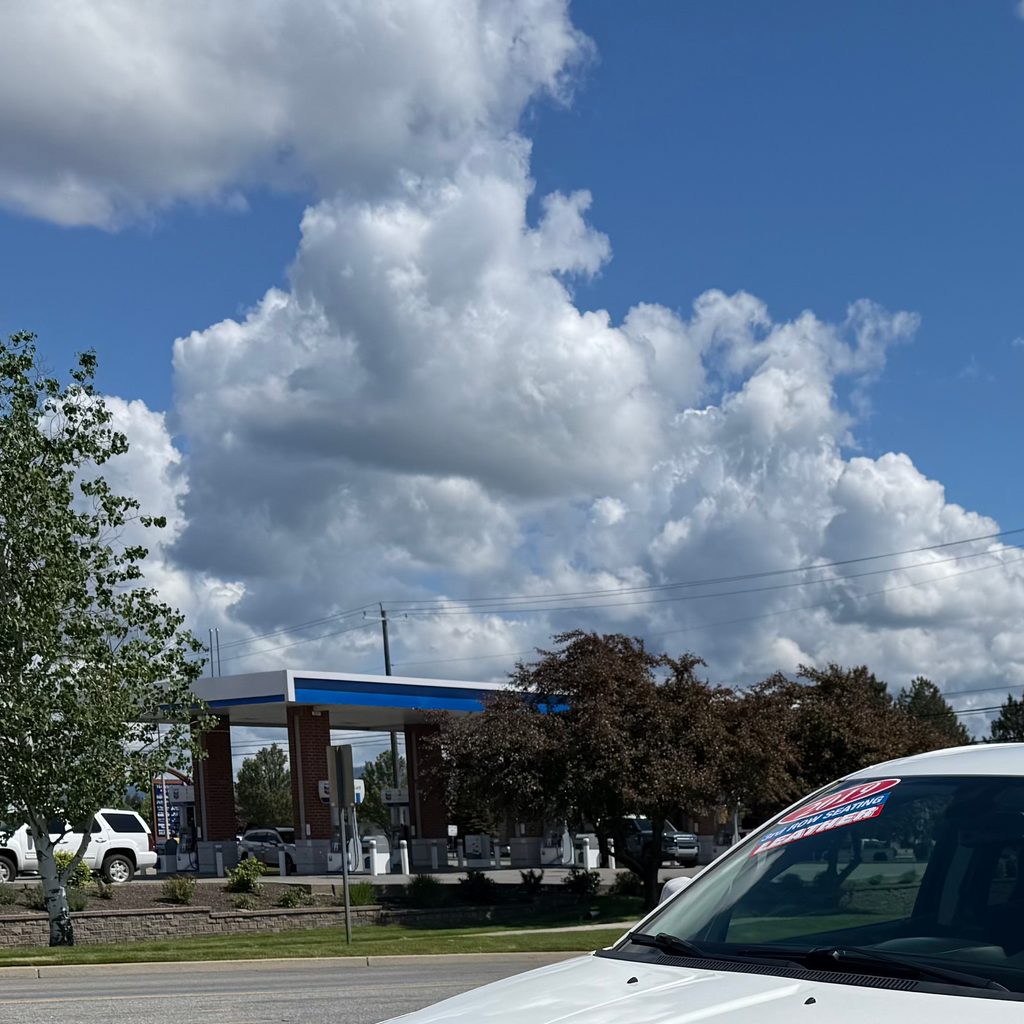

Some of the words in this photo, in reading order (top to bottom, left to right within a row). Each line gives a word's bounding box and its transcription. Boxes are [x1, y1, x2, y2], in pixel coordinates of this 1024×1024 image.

[758, 806, 879, 852] LEATHER
[786, 814, 822, 832] ROW
[823, 795, 885, 819] SEATING
